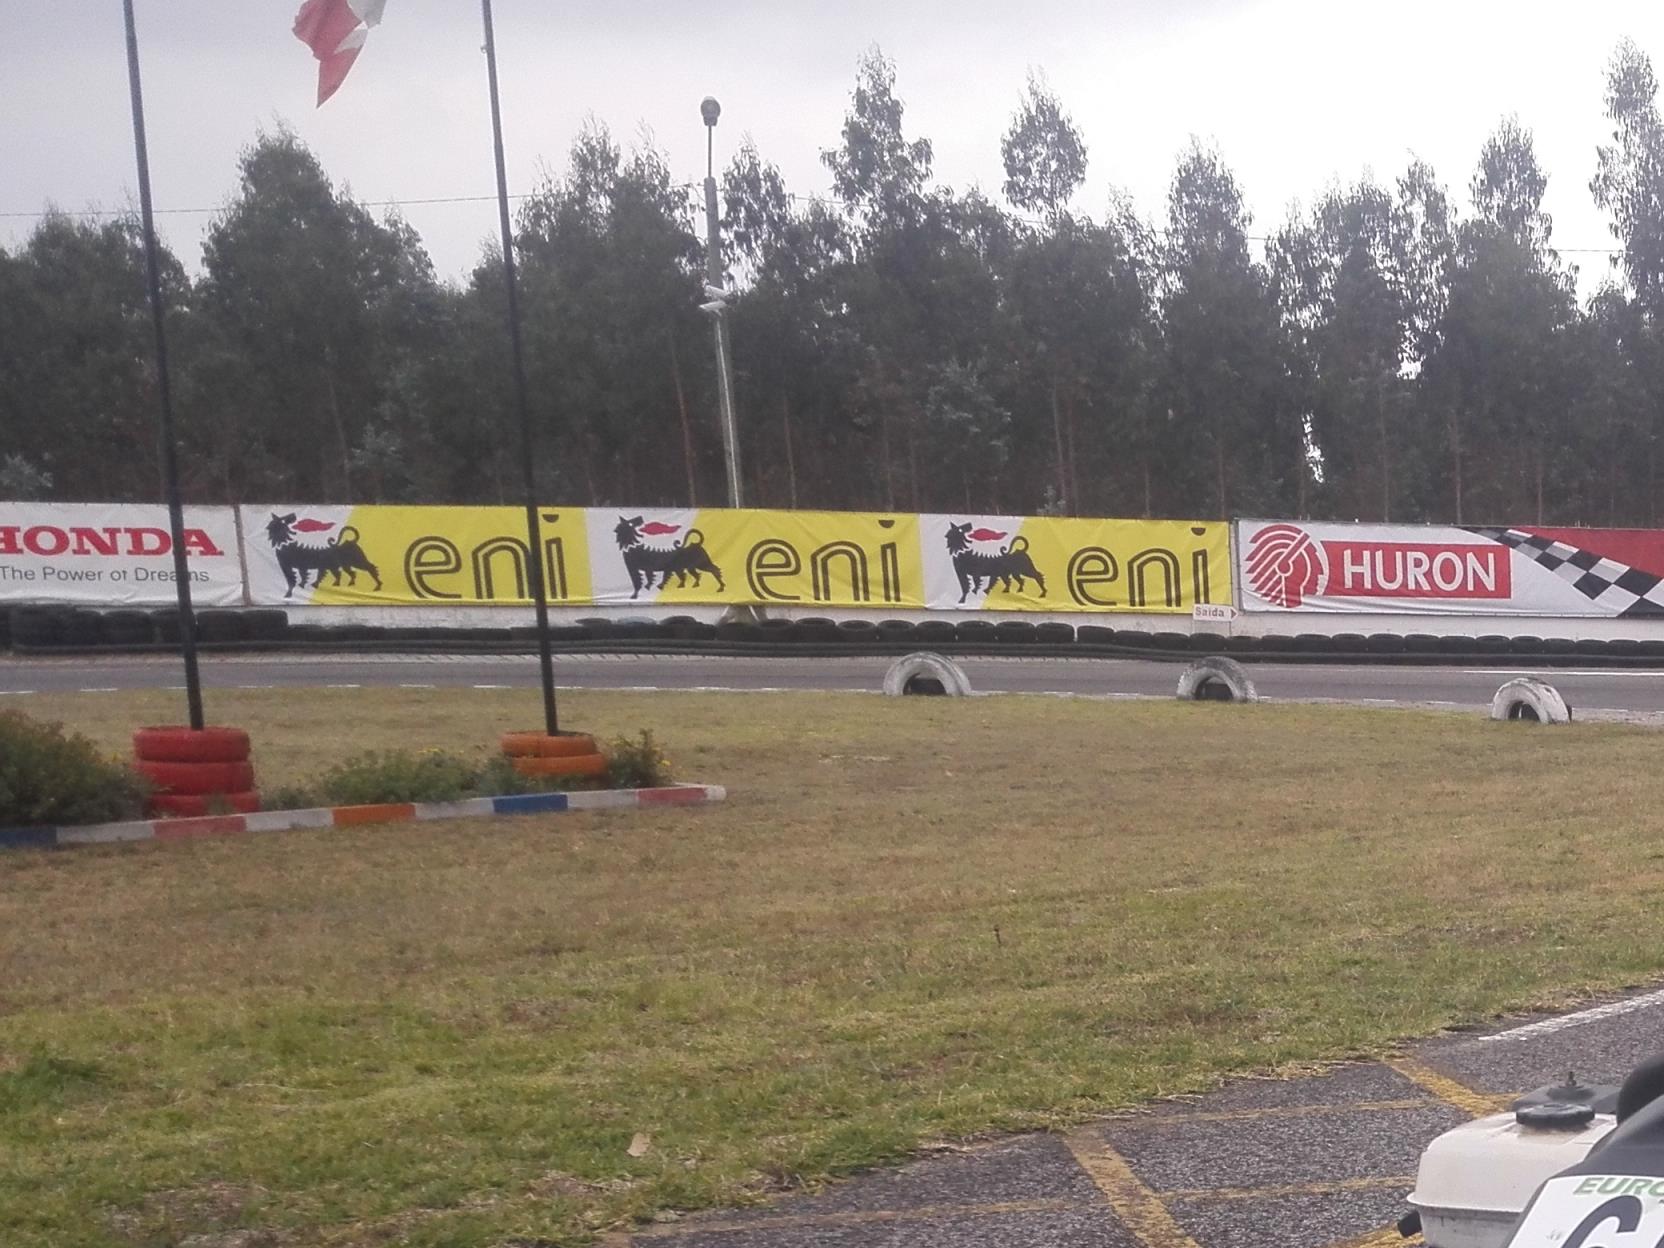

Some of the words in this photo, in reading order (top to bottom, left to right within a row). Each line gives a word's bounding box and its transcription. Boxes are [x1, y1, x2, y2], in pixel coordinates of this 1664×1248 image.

[0, 565, 36, 581] The
[43, 565, 102, 582] Power
[110, 568, 128, 582] of
[404, 514, 568, 600] eni
[745, 519, 901, 603] eni
[1067, 527, 1210, 608] eni
[1343, 549, 1496, 592] HURON
